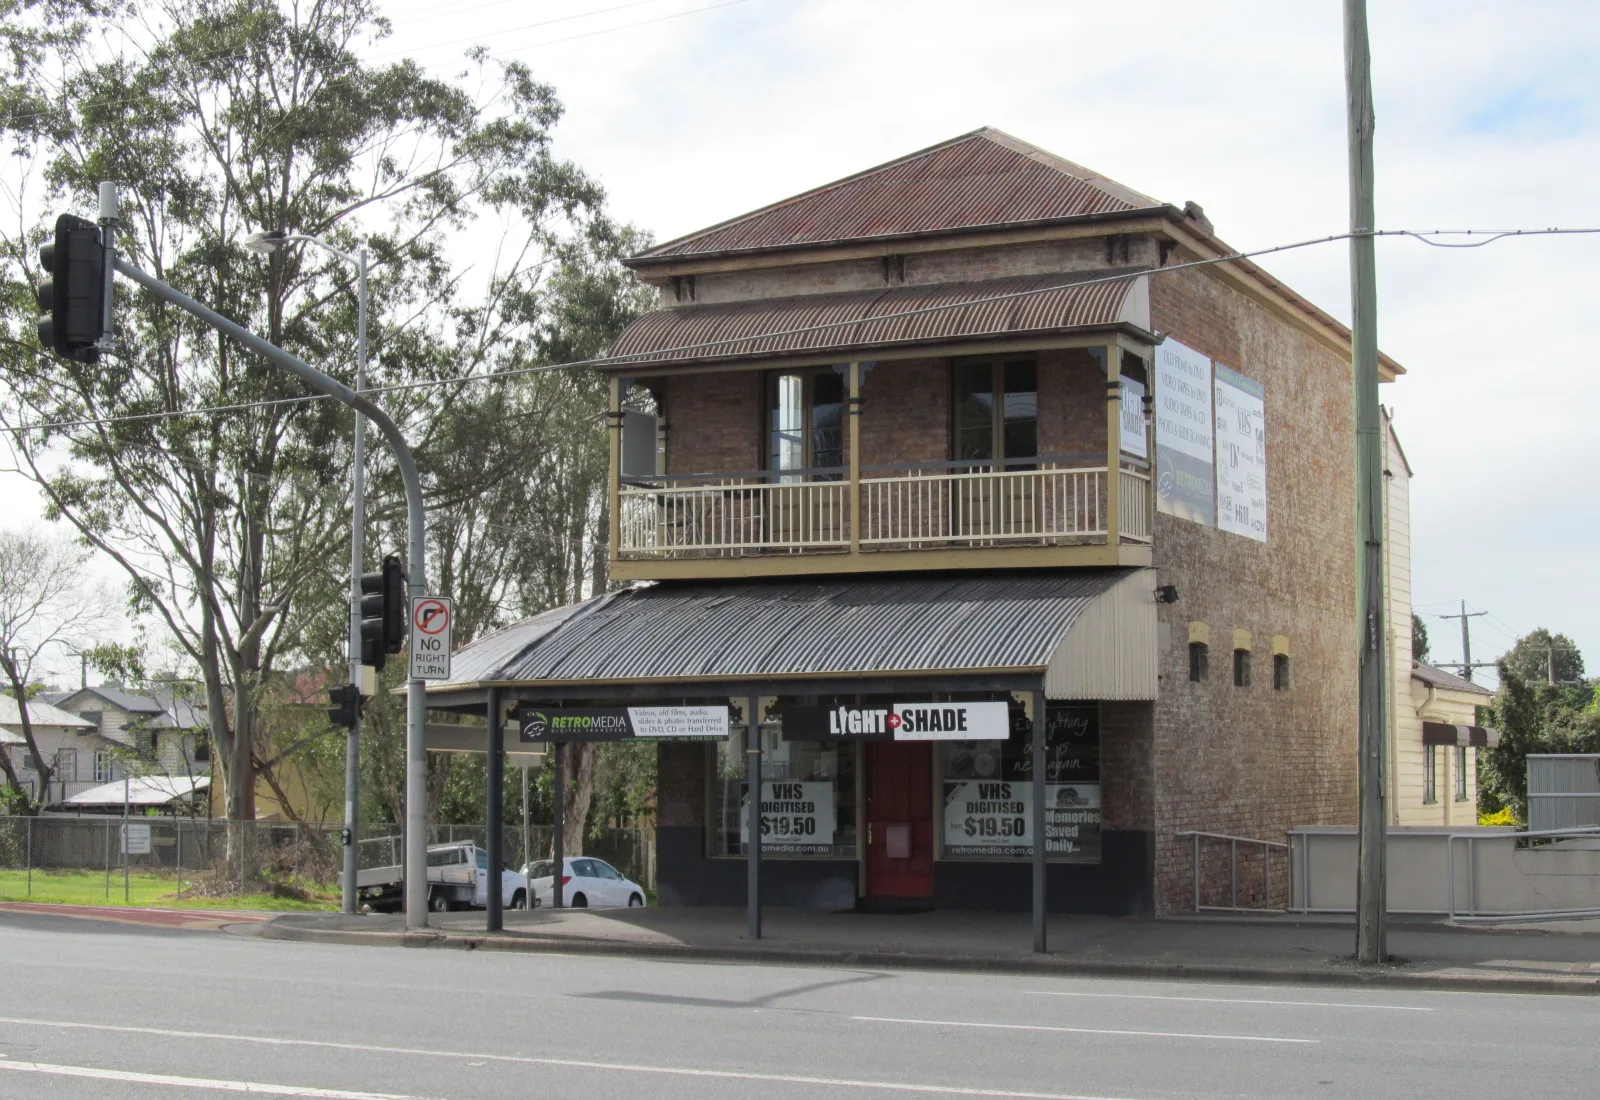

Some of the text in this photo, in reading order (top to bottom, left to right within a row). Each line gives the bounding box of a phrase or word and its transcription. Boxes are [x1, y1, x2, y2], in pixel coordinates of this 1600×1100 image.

[1194, 364, 1204, 380] DVD
[1161, 372, 1176, 390] VIDEO
[1177, 379, 1190, 397] TAPES
[1163, 396, 1179, 414] AUDIO
[1179, 402, 1192, 420] TAPES
[1199, 411, 1205, 424] CD
[1237, 409, 1251, 434] VHS
[421, 638, 441, 651] NO
[415, 654, 446, 662] RIGHT
[416, 666, 445, 674] TURN
[634, 708, 708, 717] Videos, old films, audio,
[551, 715, 626, 728] RETROMEDIA
[638, 717, 655, 725] slides
[664, 717, 685, 726] photos
[687, 716, 721, 725] transferred
[829, 705, 967, 735] LIGHT SHADE
[706, 724, 724, 732] Drive.
[1013, 760, 1033, 772] ne
[772, 784, 803, 799] VHS
[978, 783, 1011, 800] VHS
[761, 802, 815, 813] DIGITISED
[966, 802, 1024, 814] DIGITISED
[1045, 811, 1100, 824] Memories
[761, 816, 816, 836] $19.50
[964, 816, 1025, 837] $19.50
[1045, 825, 1079, 837] Saved
[952, 847, 1034, 855] retromedia.com.a
[1045, 839, 1081, 852] Daily...
